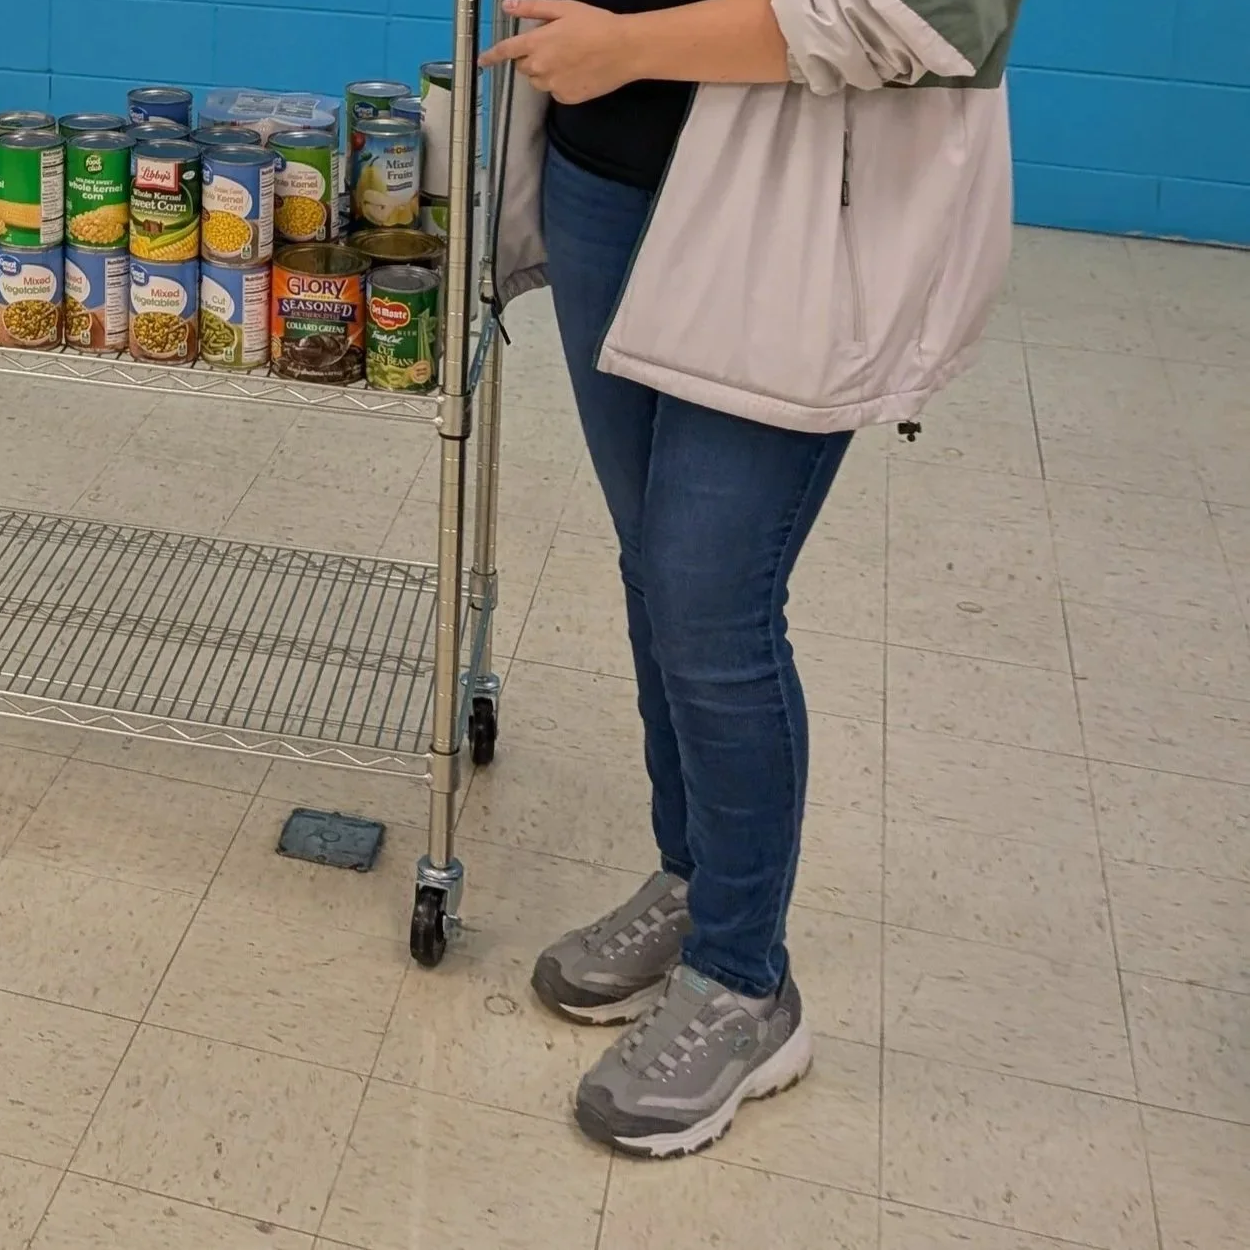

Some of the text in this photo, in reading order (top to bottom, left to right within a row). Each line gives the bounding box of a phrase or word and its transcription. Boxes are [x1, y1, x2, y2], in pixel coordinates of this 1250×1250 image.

[385, 158, 415, 169] Mixed
[141, 166, 171, 182] Libby's
[68, 180, 123, 193] whole kernel
[290, 180, 318, 188] Kernel
[81, 192, 104, 200] corn
[153, 192, 182, 202] Kernel
[216, 194, 244, 204] Kernel
[156, 201, 187, 212] Corn
[23, 276, 51, 285] Mixed
[2, 282, 51, 295] Vegetables
[150, 288, 180, 298] Mixed
[286, 276, 348, 299] GLORY
[133, 292, 180, 307] Vegetables
[211, 295, 226, 306] Cut
[281, 299, 353, 318] SEASONED
[381, 308, 407, 320] Monte
[285, 321, 345, 333] COLLARD GREENS
[377, 345, 395, 358] CUT
[387, 356, 415, 367] BEANS
